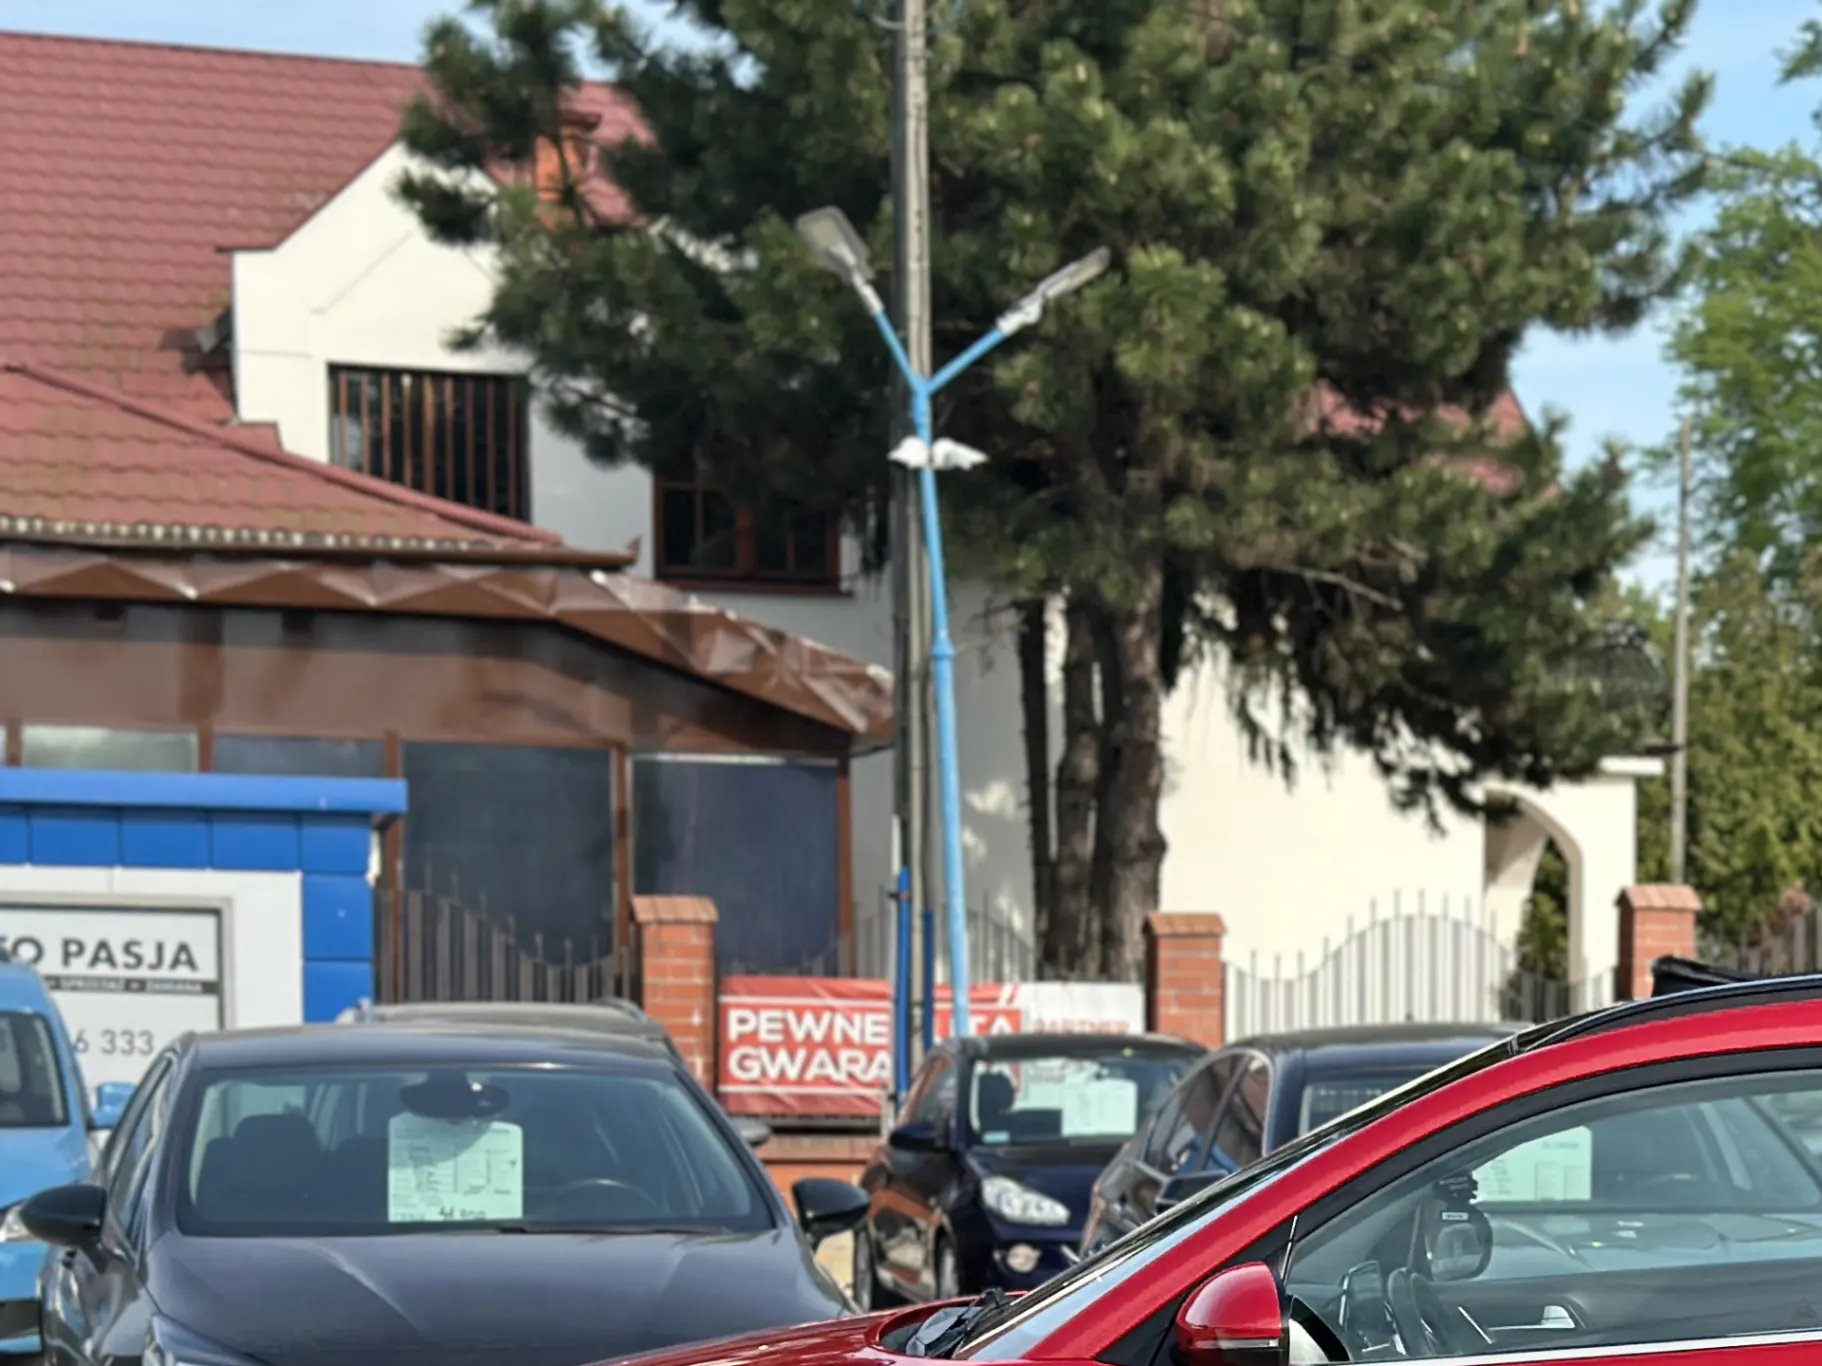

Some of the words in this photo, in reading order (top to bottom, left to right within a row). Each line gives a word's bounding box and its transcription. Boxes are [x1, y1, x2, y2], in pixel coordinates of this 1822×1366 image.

[0, 936, 44, 966] O
[61, 938, 199, 971] PASJA
[99, 1030, 154, 1056] 333
[727, 1008, 890, 1045] PEWNE
